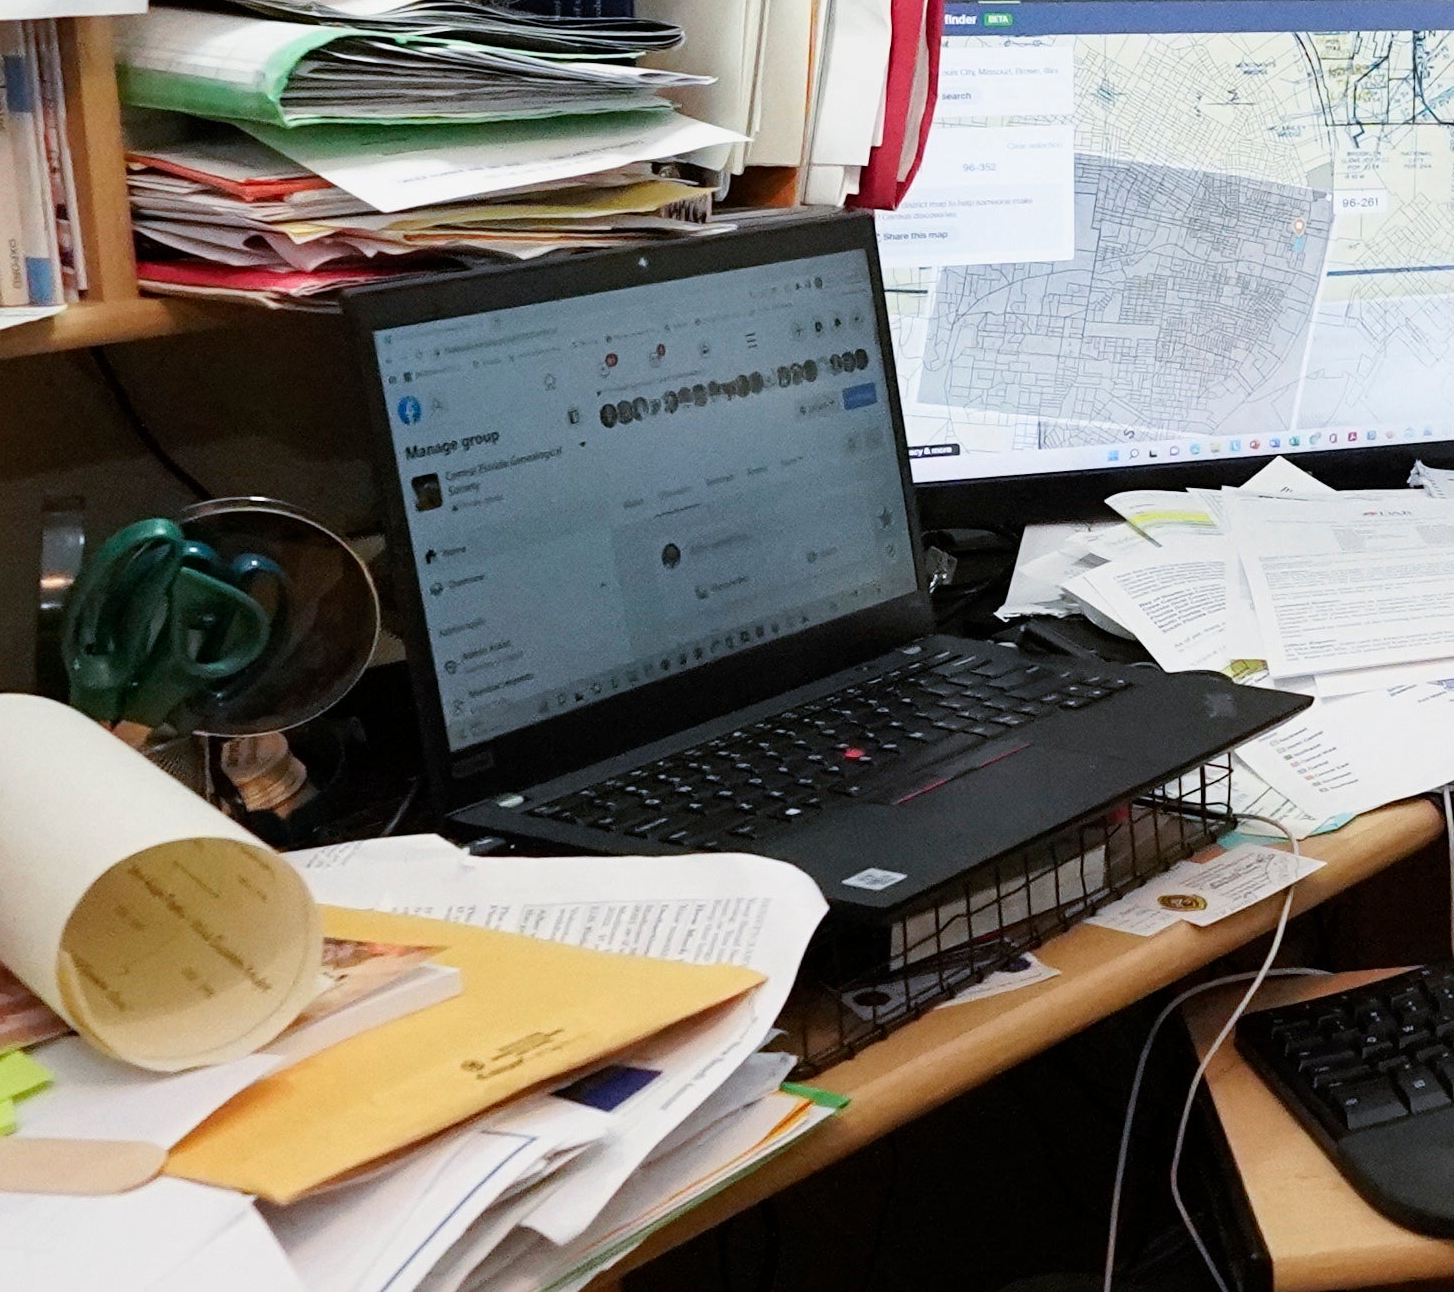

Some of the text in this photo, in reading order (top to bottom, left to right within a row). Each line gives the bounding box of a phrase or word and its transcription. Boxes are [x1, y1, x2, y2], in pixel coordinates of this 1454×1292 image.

[987, 14, 1010, 25] BETA
[942, 67, 959, 76] ouis
[942, 91, 972, 101] search
[962, 162, 996, 172] 96-352
[1341, 197, 1380, 209] 96-261
[883, 231, 949, 241] Share this map
[405, 430, 501, 461] Manage group
[931, 446, 953, 455] more
